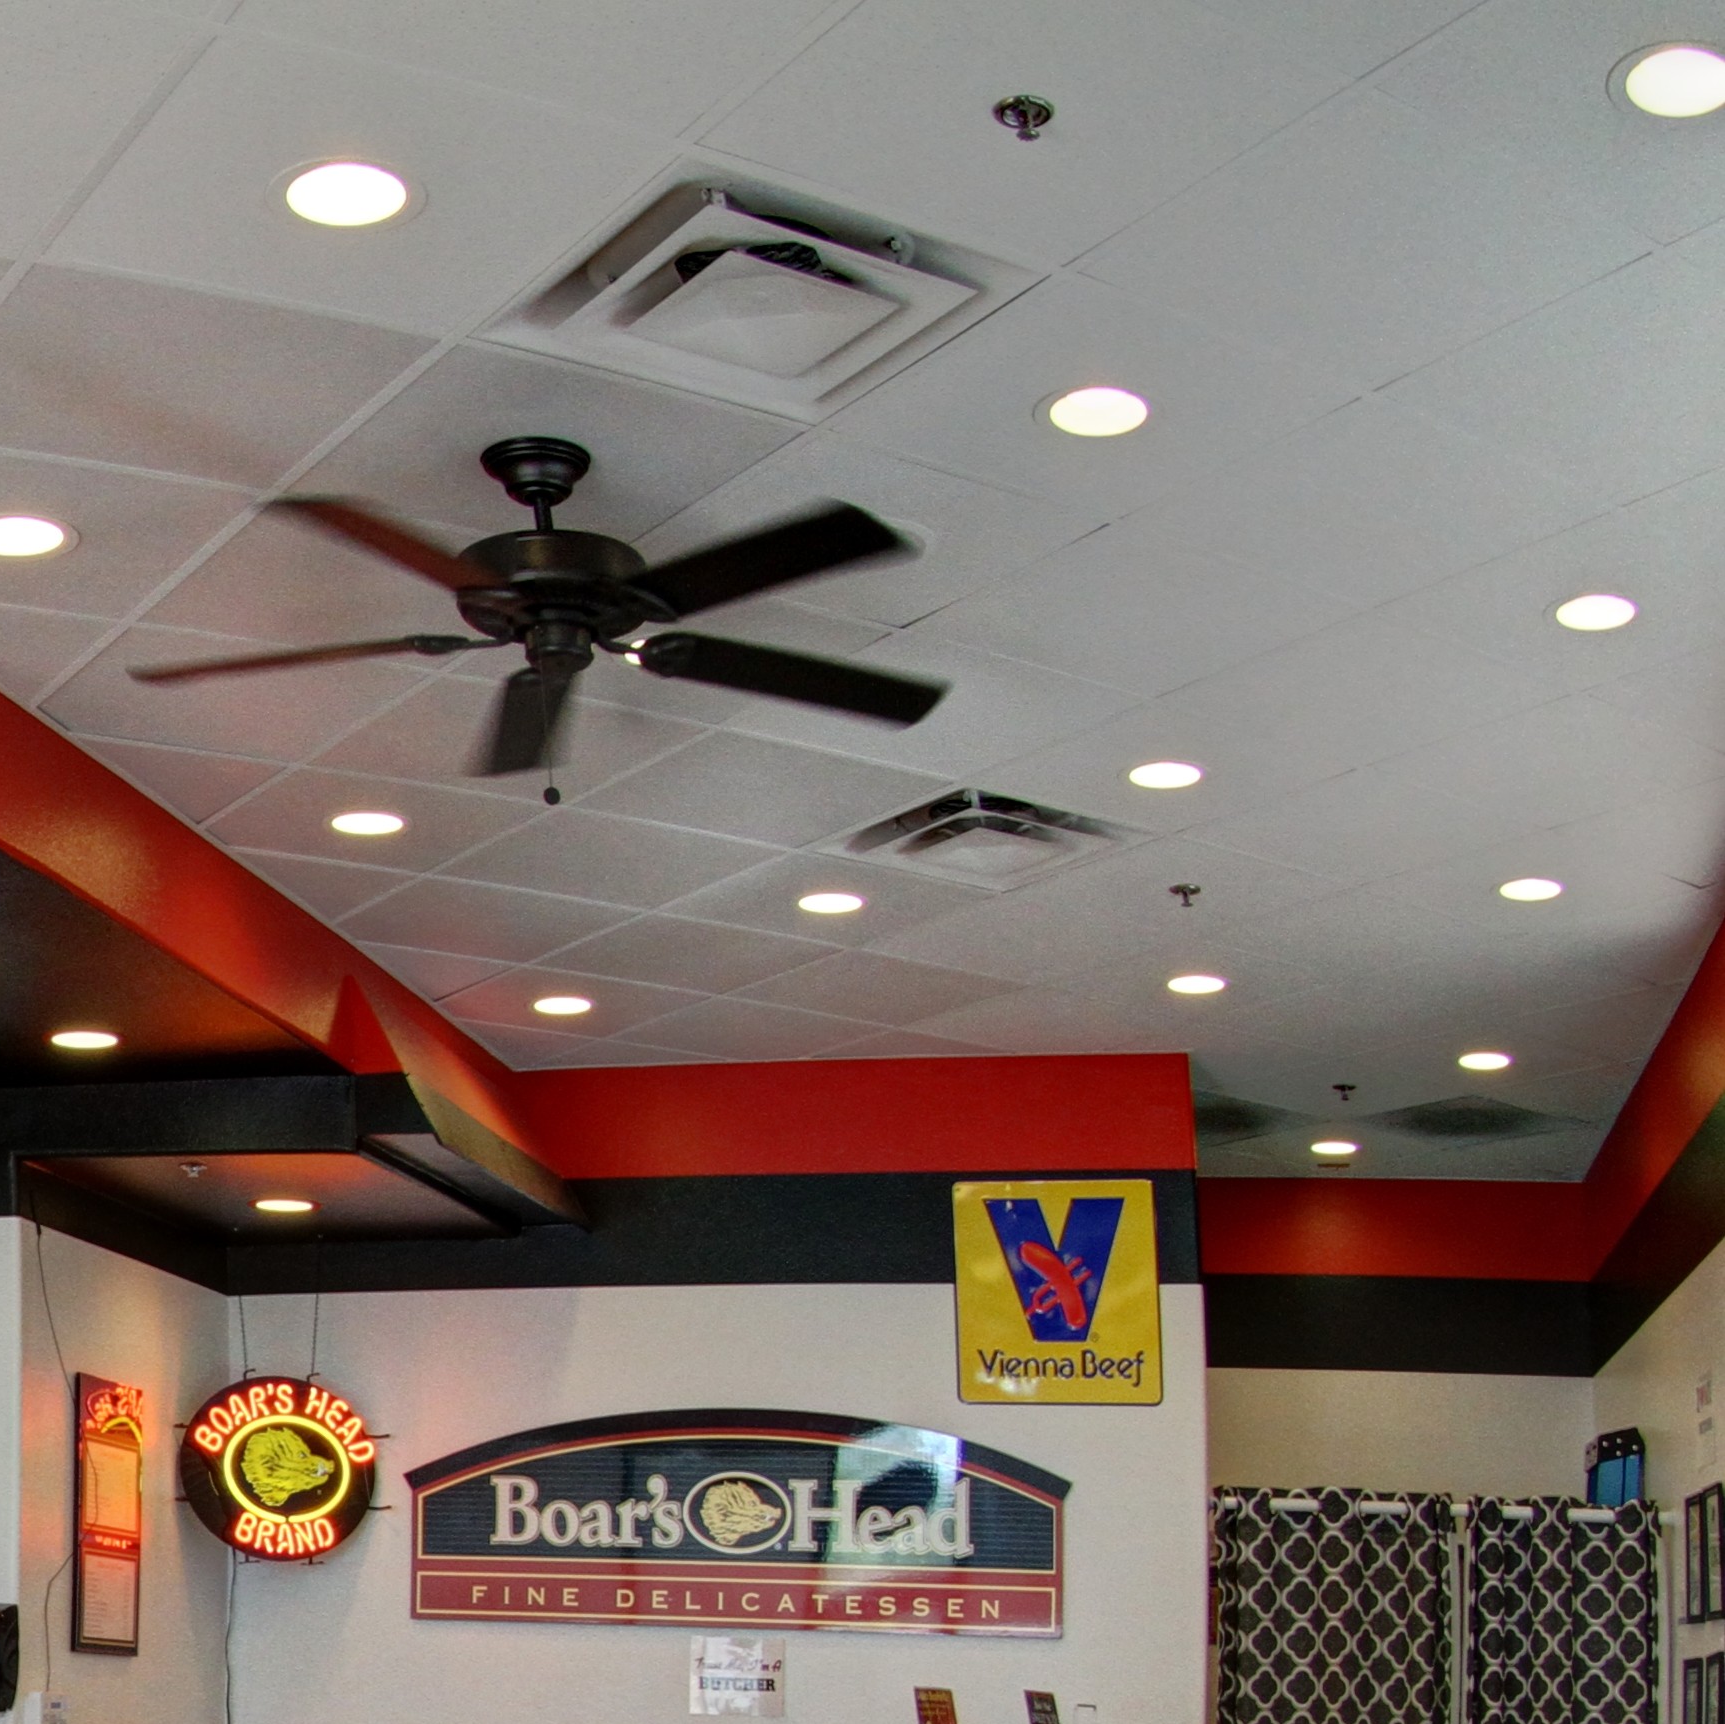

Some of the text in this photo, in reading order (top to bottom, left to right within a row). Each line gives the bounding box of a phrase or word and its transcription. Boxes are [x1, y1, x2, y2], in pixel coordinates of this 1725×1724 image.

[977, 1349, 1144, 1387] Vienna Beef
[194, 1383, 294, 1453] BOAR'S
[306, 1387, 375, 1463] HEAD
[234, 1512, 335, 1555] BRAND
[489, 1473, 974, 1557] Boar's Head
[473, 1585, 1001, 1619] FINE DELICATESSEN
[699, 1676, 776, 1692] BUTCHER
